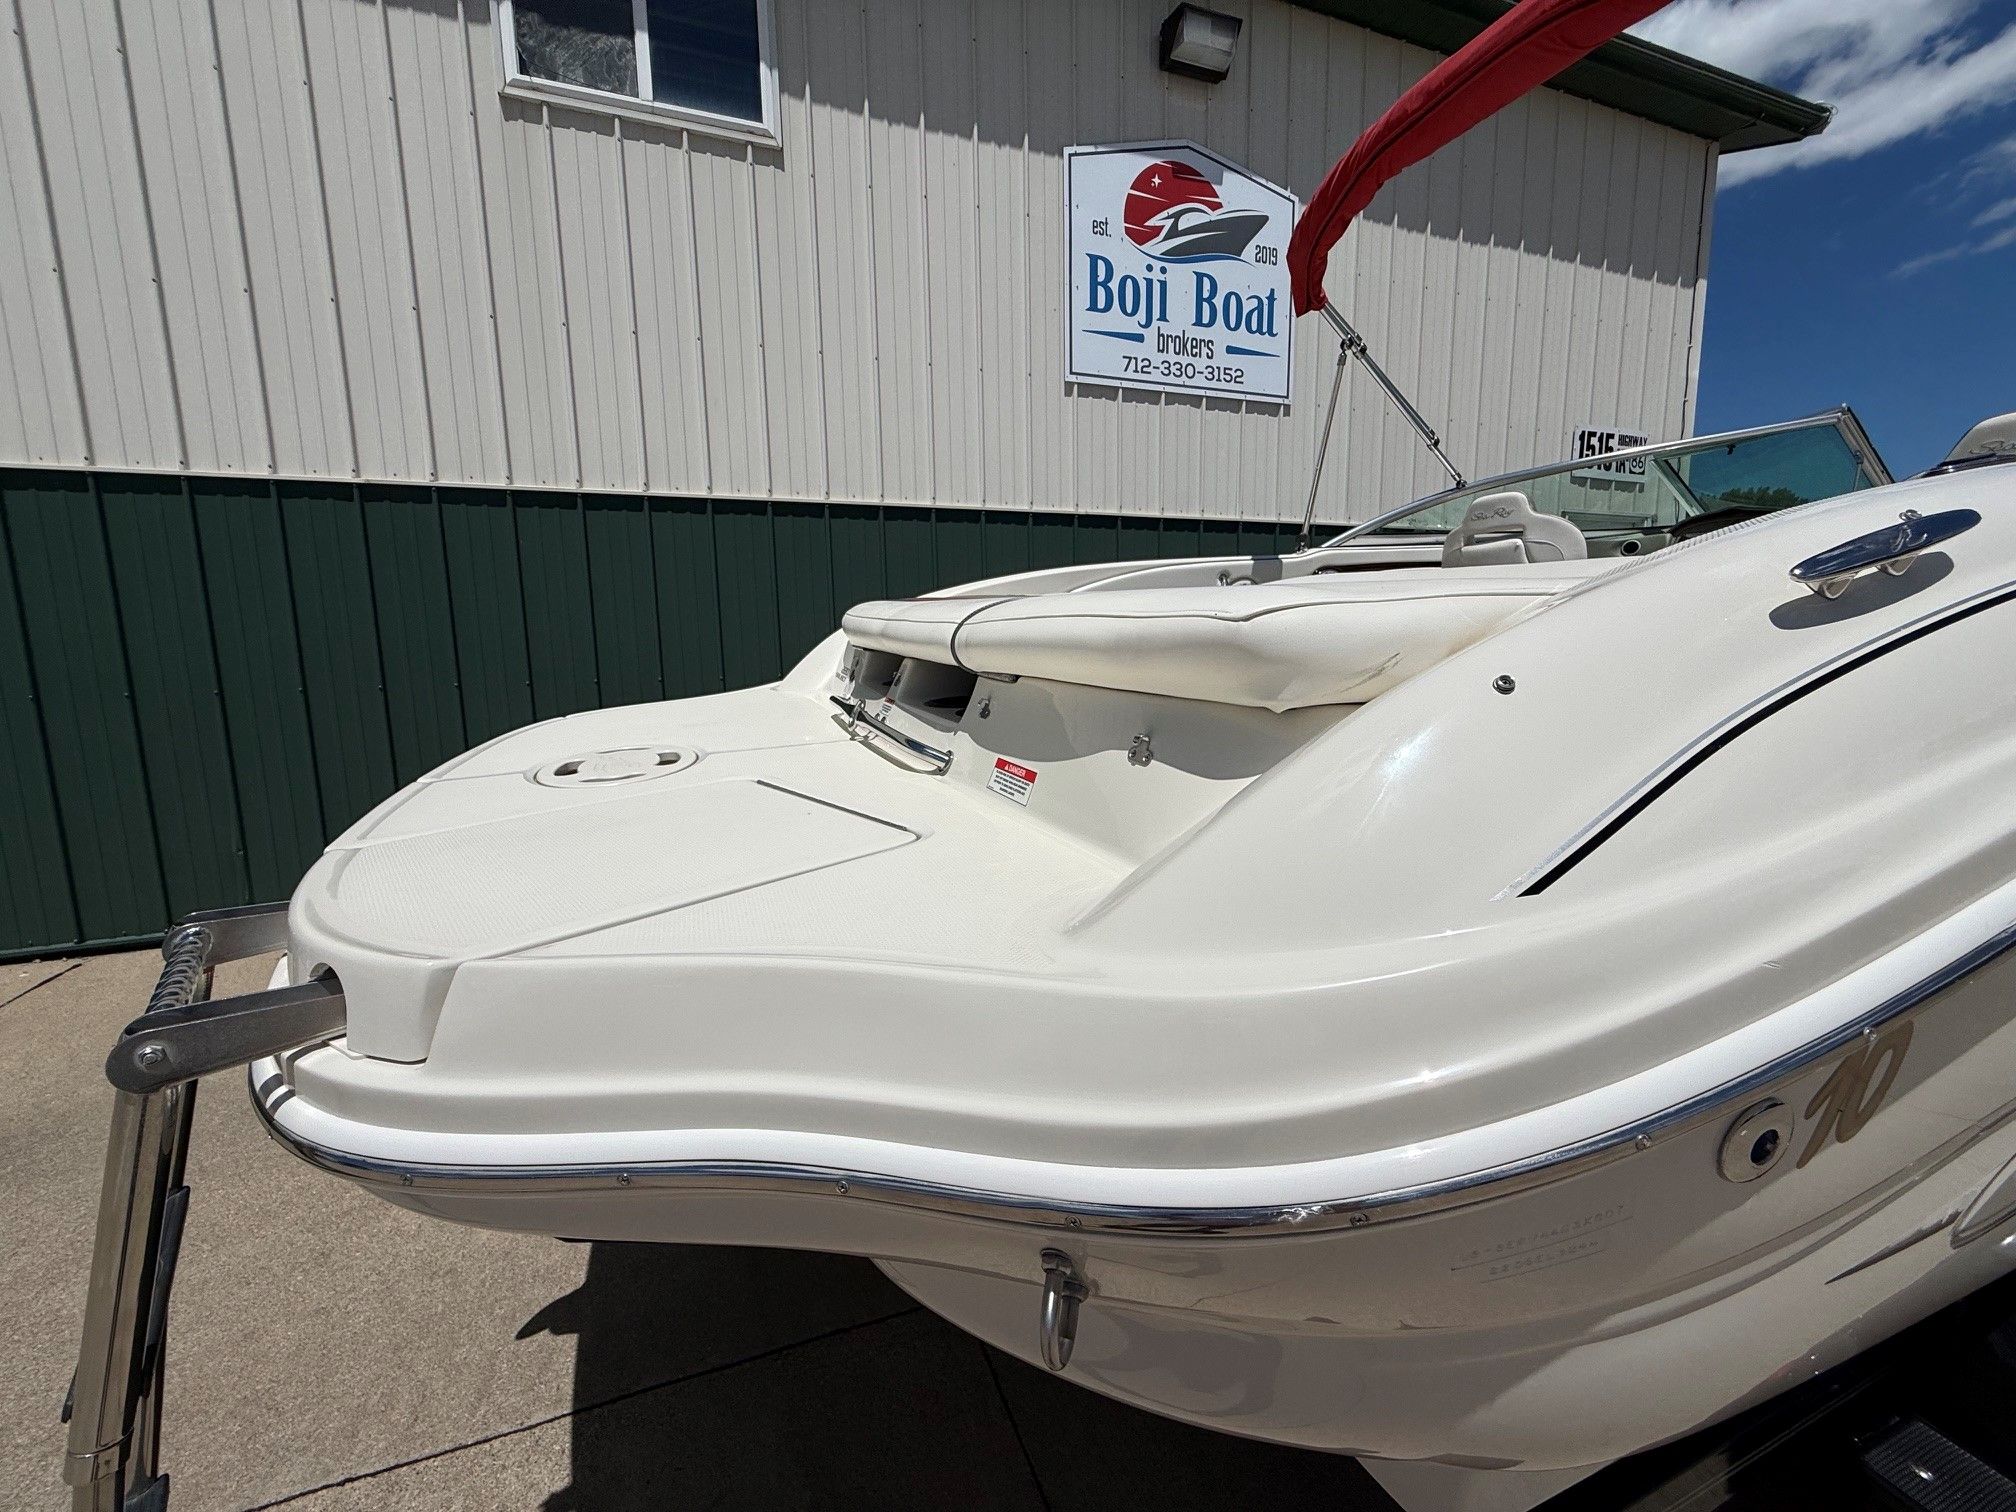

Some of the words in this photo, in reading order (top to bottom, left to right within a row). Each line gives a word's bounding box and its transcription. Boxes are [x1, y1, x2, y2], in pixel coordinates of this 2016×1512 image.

[1092, 216, 1112, 238] est.
[1254, 244, 1278, 266] 2019
[1085, 252, 1170, 329] Boji
[1191, 270, 1279, 337] Boat
[1156, 326, 1214, 360] brokers
[1122, 355, 1245, 384] 712-330-3152
[1618, 434, 1648, 447] HIGHWAY
